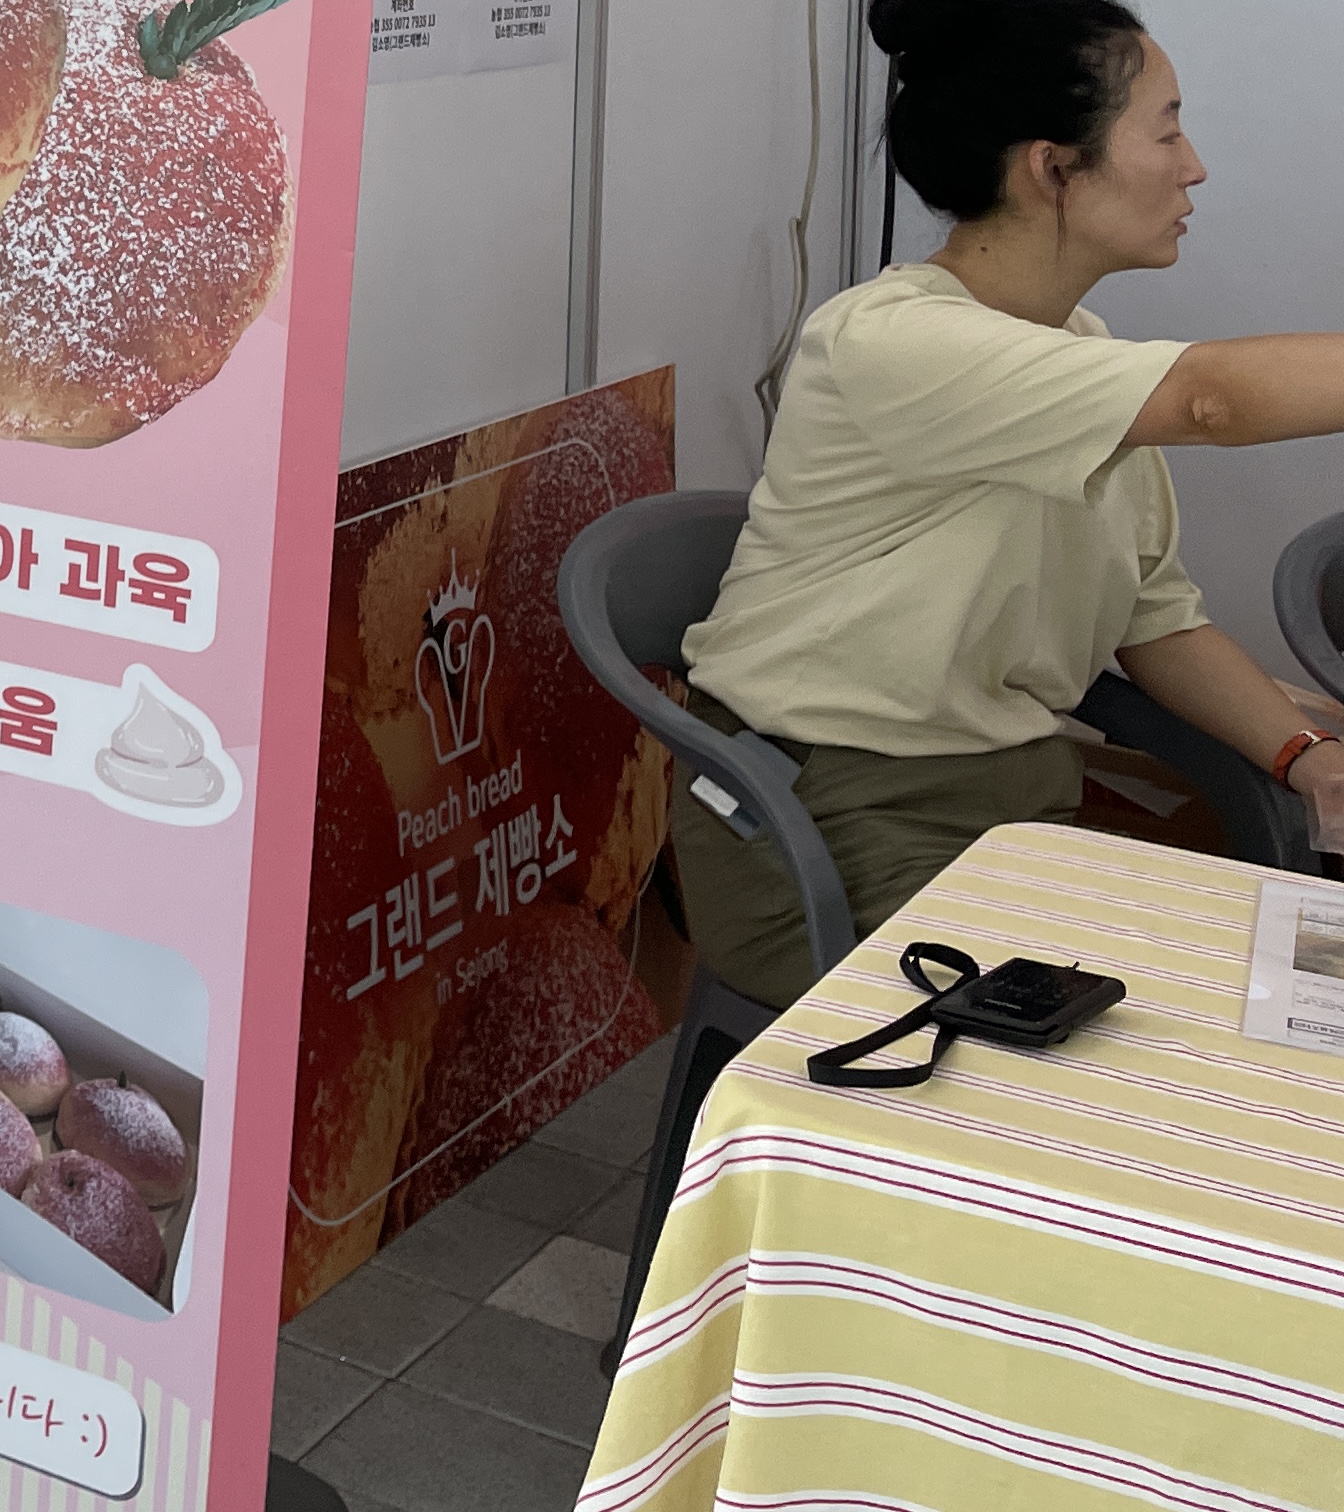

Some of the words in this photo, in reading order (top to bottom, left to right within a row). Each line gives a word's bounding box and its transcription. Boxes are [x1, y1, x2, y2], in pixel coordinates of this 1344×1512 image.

[57, 535, 194, 623] 과육
[443, 618, 469, 675] G
[397, 786, 461, 858] Peach
[468, 749, 522, 819] bread
[347, 856, 464, 1001] 그랜드
[474, 793, 577, 916] 제빵소
[437, 971, 452, 1005] in
[456, 938, 508, 994] Sejong
